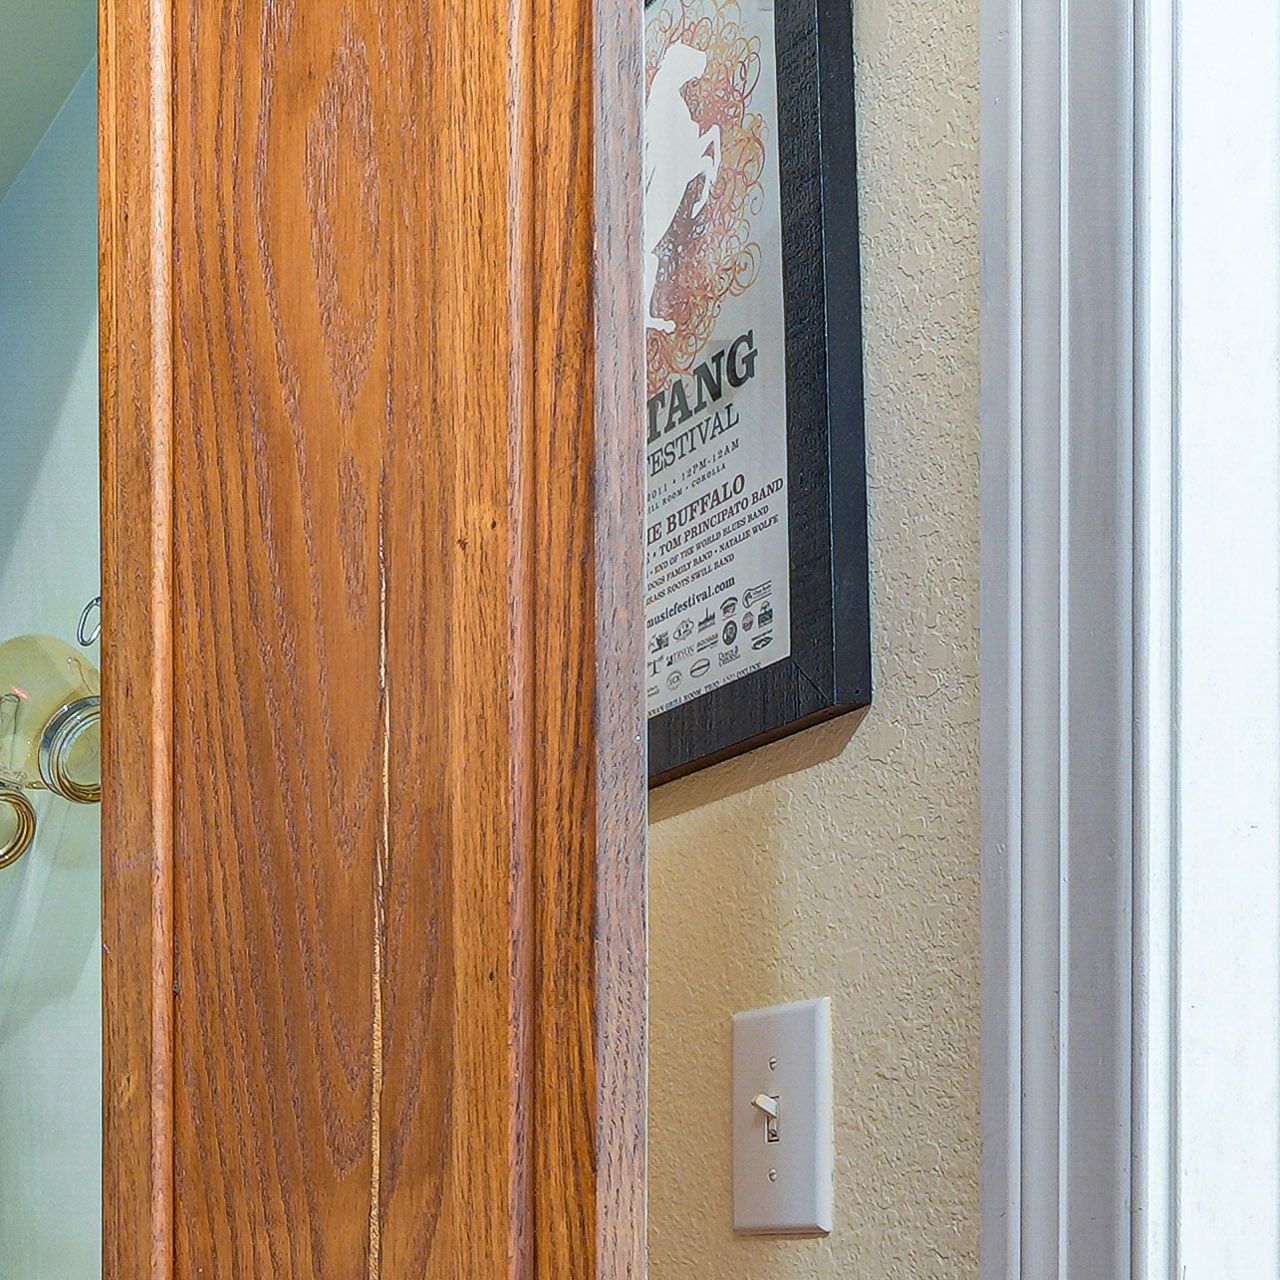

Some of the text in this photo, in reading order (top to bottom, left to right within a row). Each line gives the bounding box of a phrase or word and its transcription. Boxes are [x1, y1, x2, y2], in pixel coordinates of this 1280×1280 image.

[646, 402, 740, 477] ESTIVAL
[659, 477, 784, 557] TOM PRINCIPATO BAND
[666, 473, 745, 535] BUFFALO
